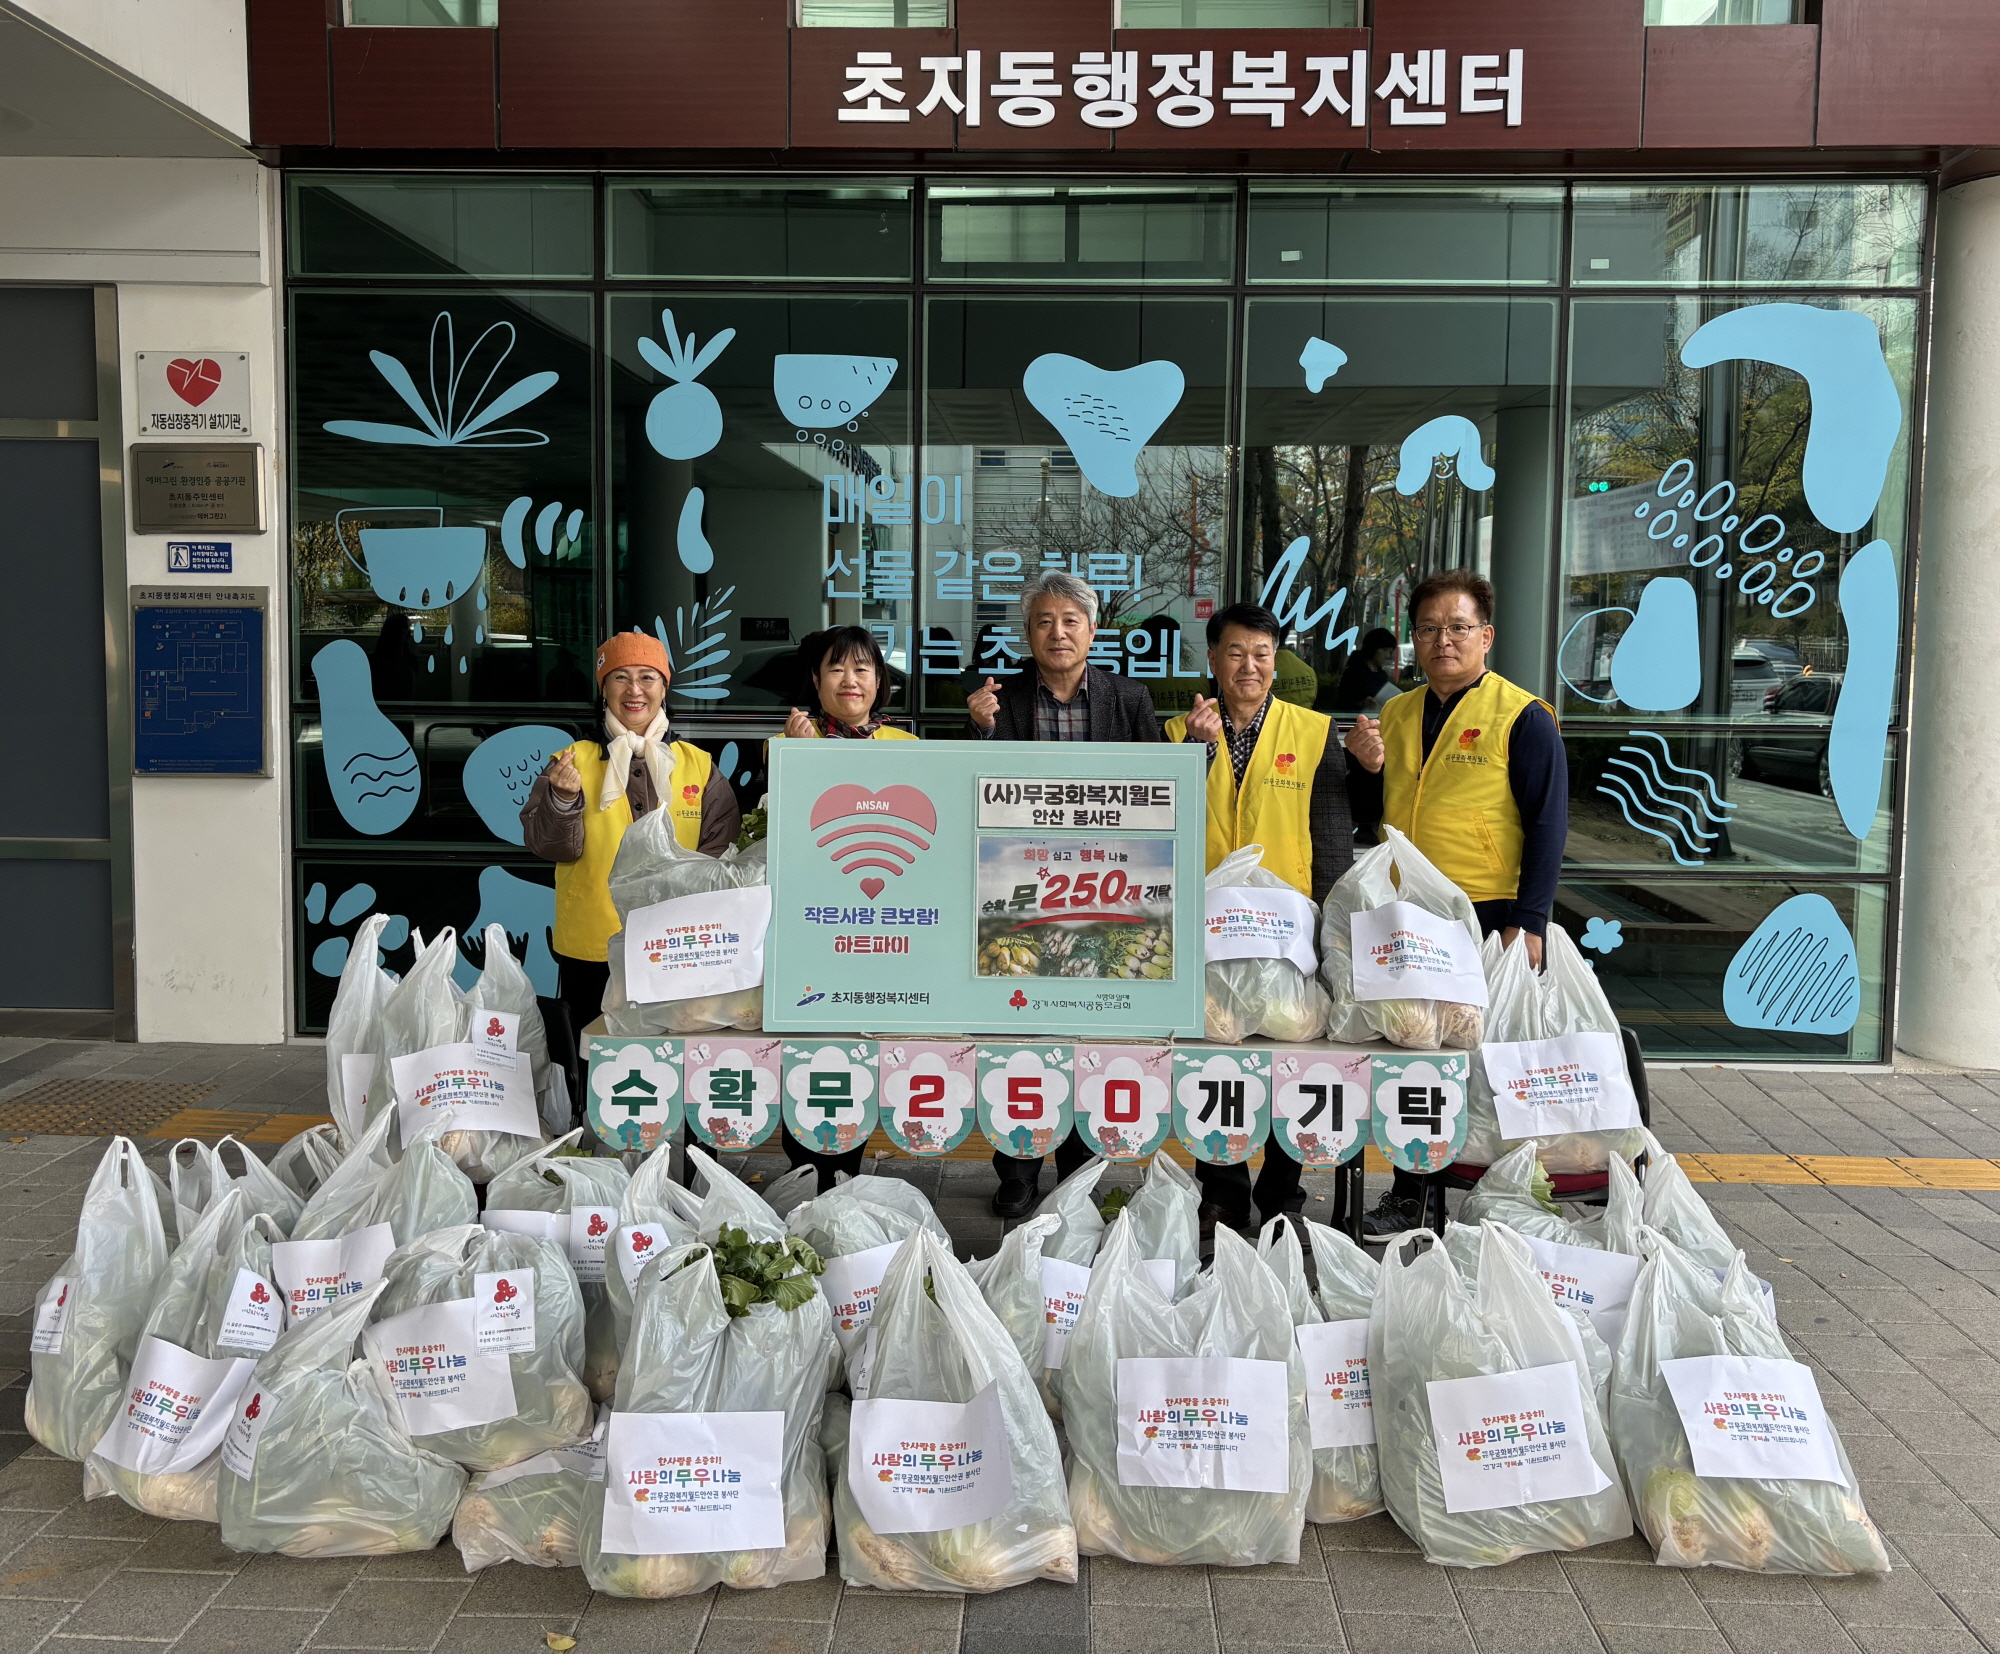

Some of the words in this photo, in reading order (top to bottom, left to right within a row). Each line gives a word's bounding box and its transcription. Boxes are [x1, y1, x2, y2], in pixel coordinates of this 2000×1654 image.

[837, 49, 1523, 128] 초지동행정복지센터
[151, 414, 207, 429] 자동심장충격기
[209, 414, 240, 429] 설치기관
[824, 474, 961, 525] 매일이
[824, 549, 914, 599] 선물
[934, 550, 1024, 601] 같은
[140, 592, 211, 600] 초지동행정복지센터
[984, 784, 1171, 806] (사)무궁화복지월드
[856, 800, 889, 812] ANSAN
[1033, 809, 1064, 825] 안산
[1073, 810, 1121, 826] 봉사단
[1024, 848, 1049, 861] 희망
[1053, 852, 1072, 861] 심고
[1080, 849, 1105, 862] 행복
[1109, 853, 1128, 862] 나눔
[1144, 884, 1171, 899] 기탁
[804, 907, 876, 925] 작은사랑
[881, 908, 939, 925] 큰보람!
[835, 935, 909, 954] 하트파이
[831, 992, 929, 1004] 초지동행정복지센터
[1032, 1000, 1131, 1011] 경기사회복지공동모금회
[1165, 1398, 1199, 1407] 한사람을
[1724, 1392, 1757, 1401] 한사람을
[1482, 1413, 1516, 1426] 한사람을
[900, 1442, 936, 1452] 한사람을
[658, 1457, 692, 1466] 한사람을
